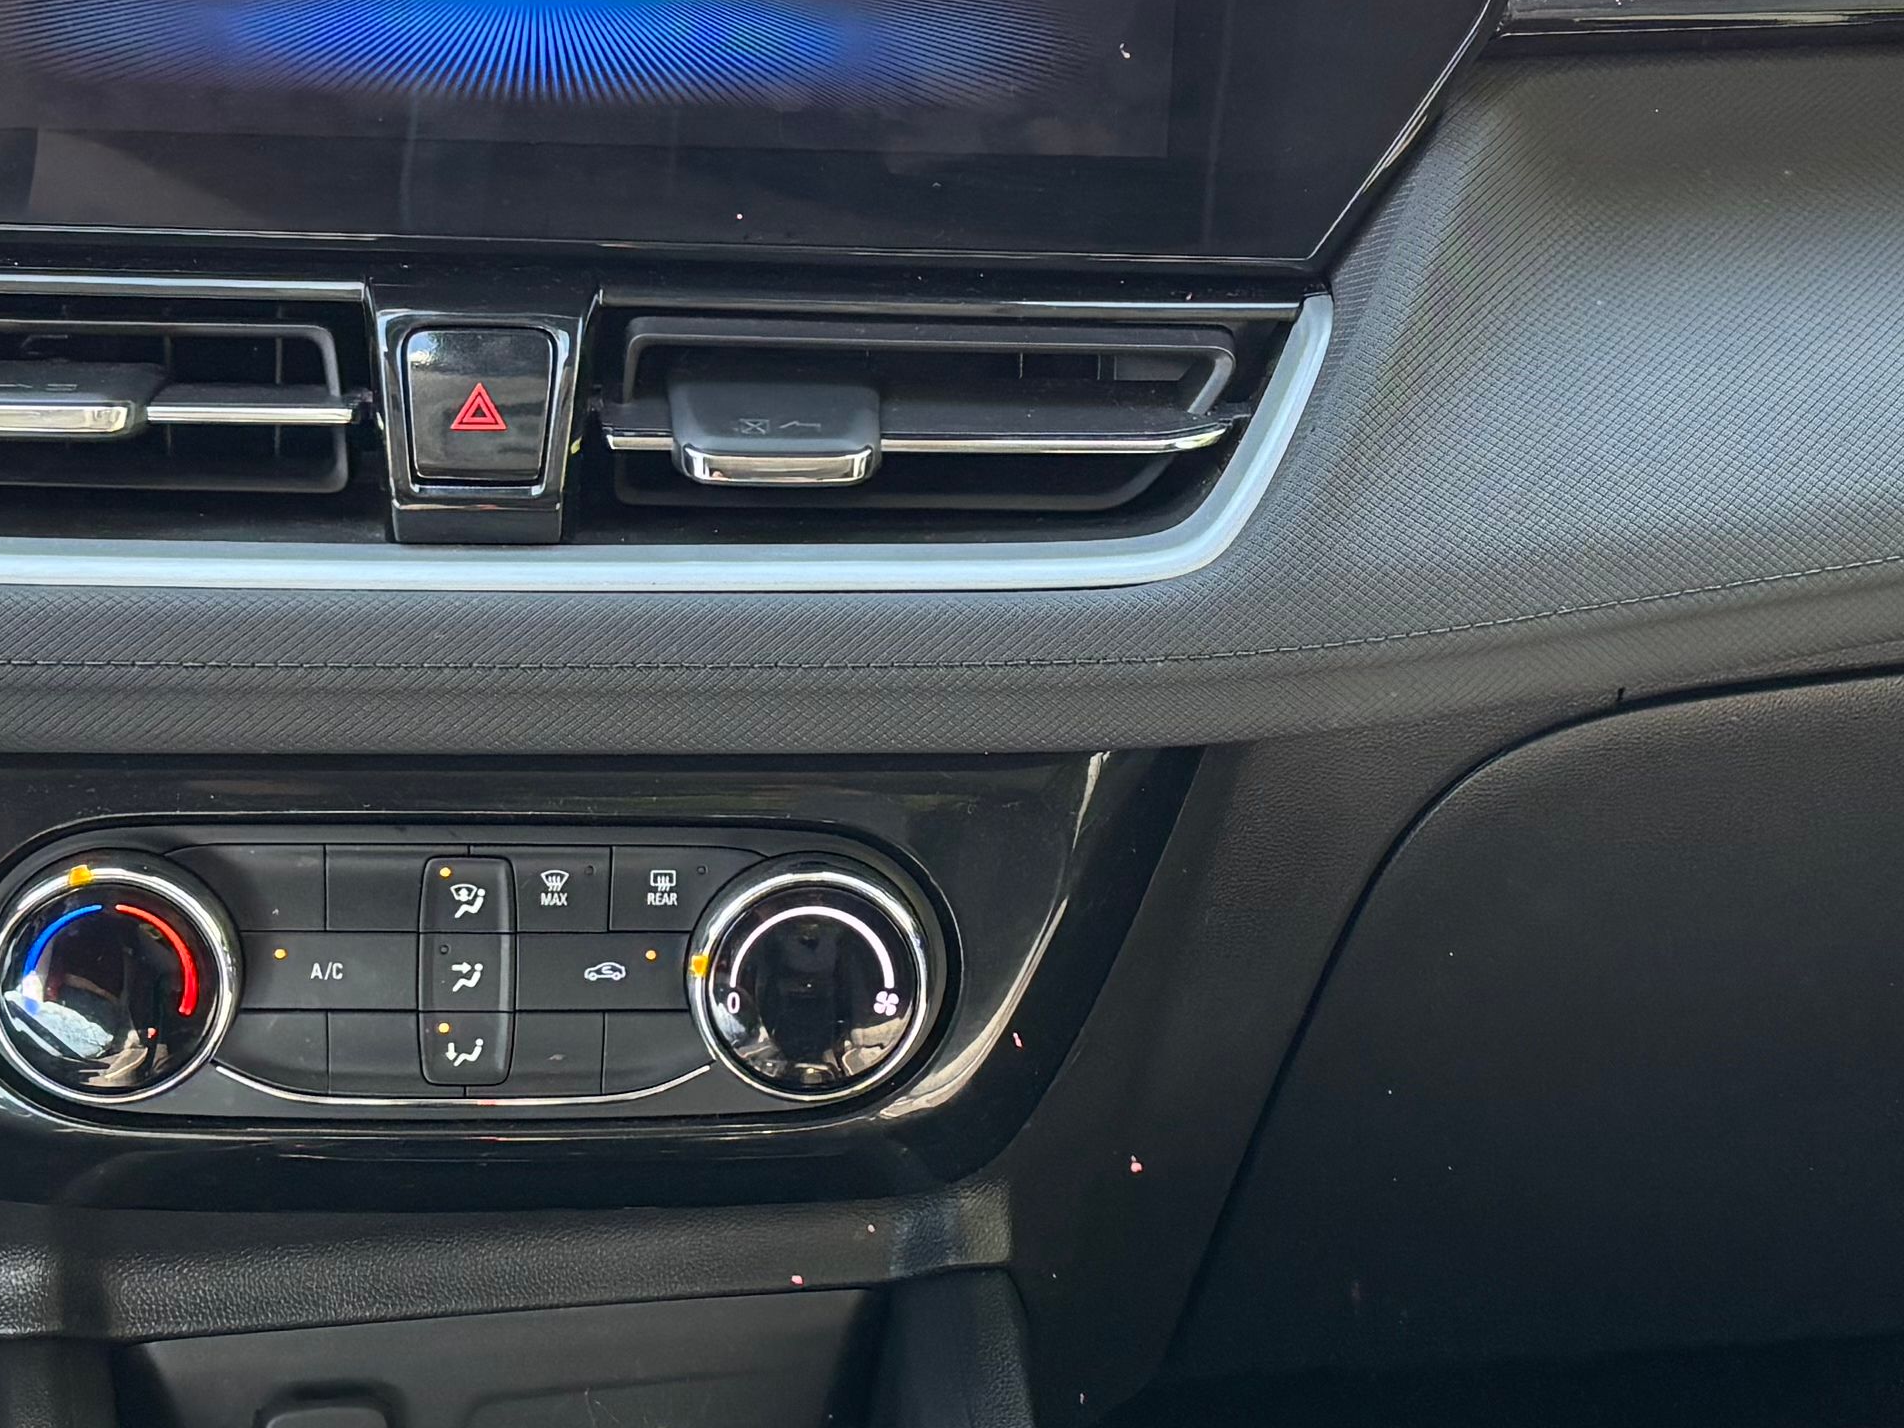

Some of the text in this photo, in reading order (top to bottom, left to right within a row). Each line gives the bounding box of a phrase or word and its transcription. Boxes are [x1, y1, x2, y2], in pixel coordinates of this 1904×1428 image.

[540, 891, 568, 907] MAX
[646, 890, 678, 907] REAR
[310, 961, 344, 982] A/C
[726, 992, 741, 1014] 0
